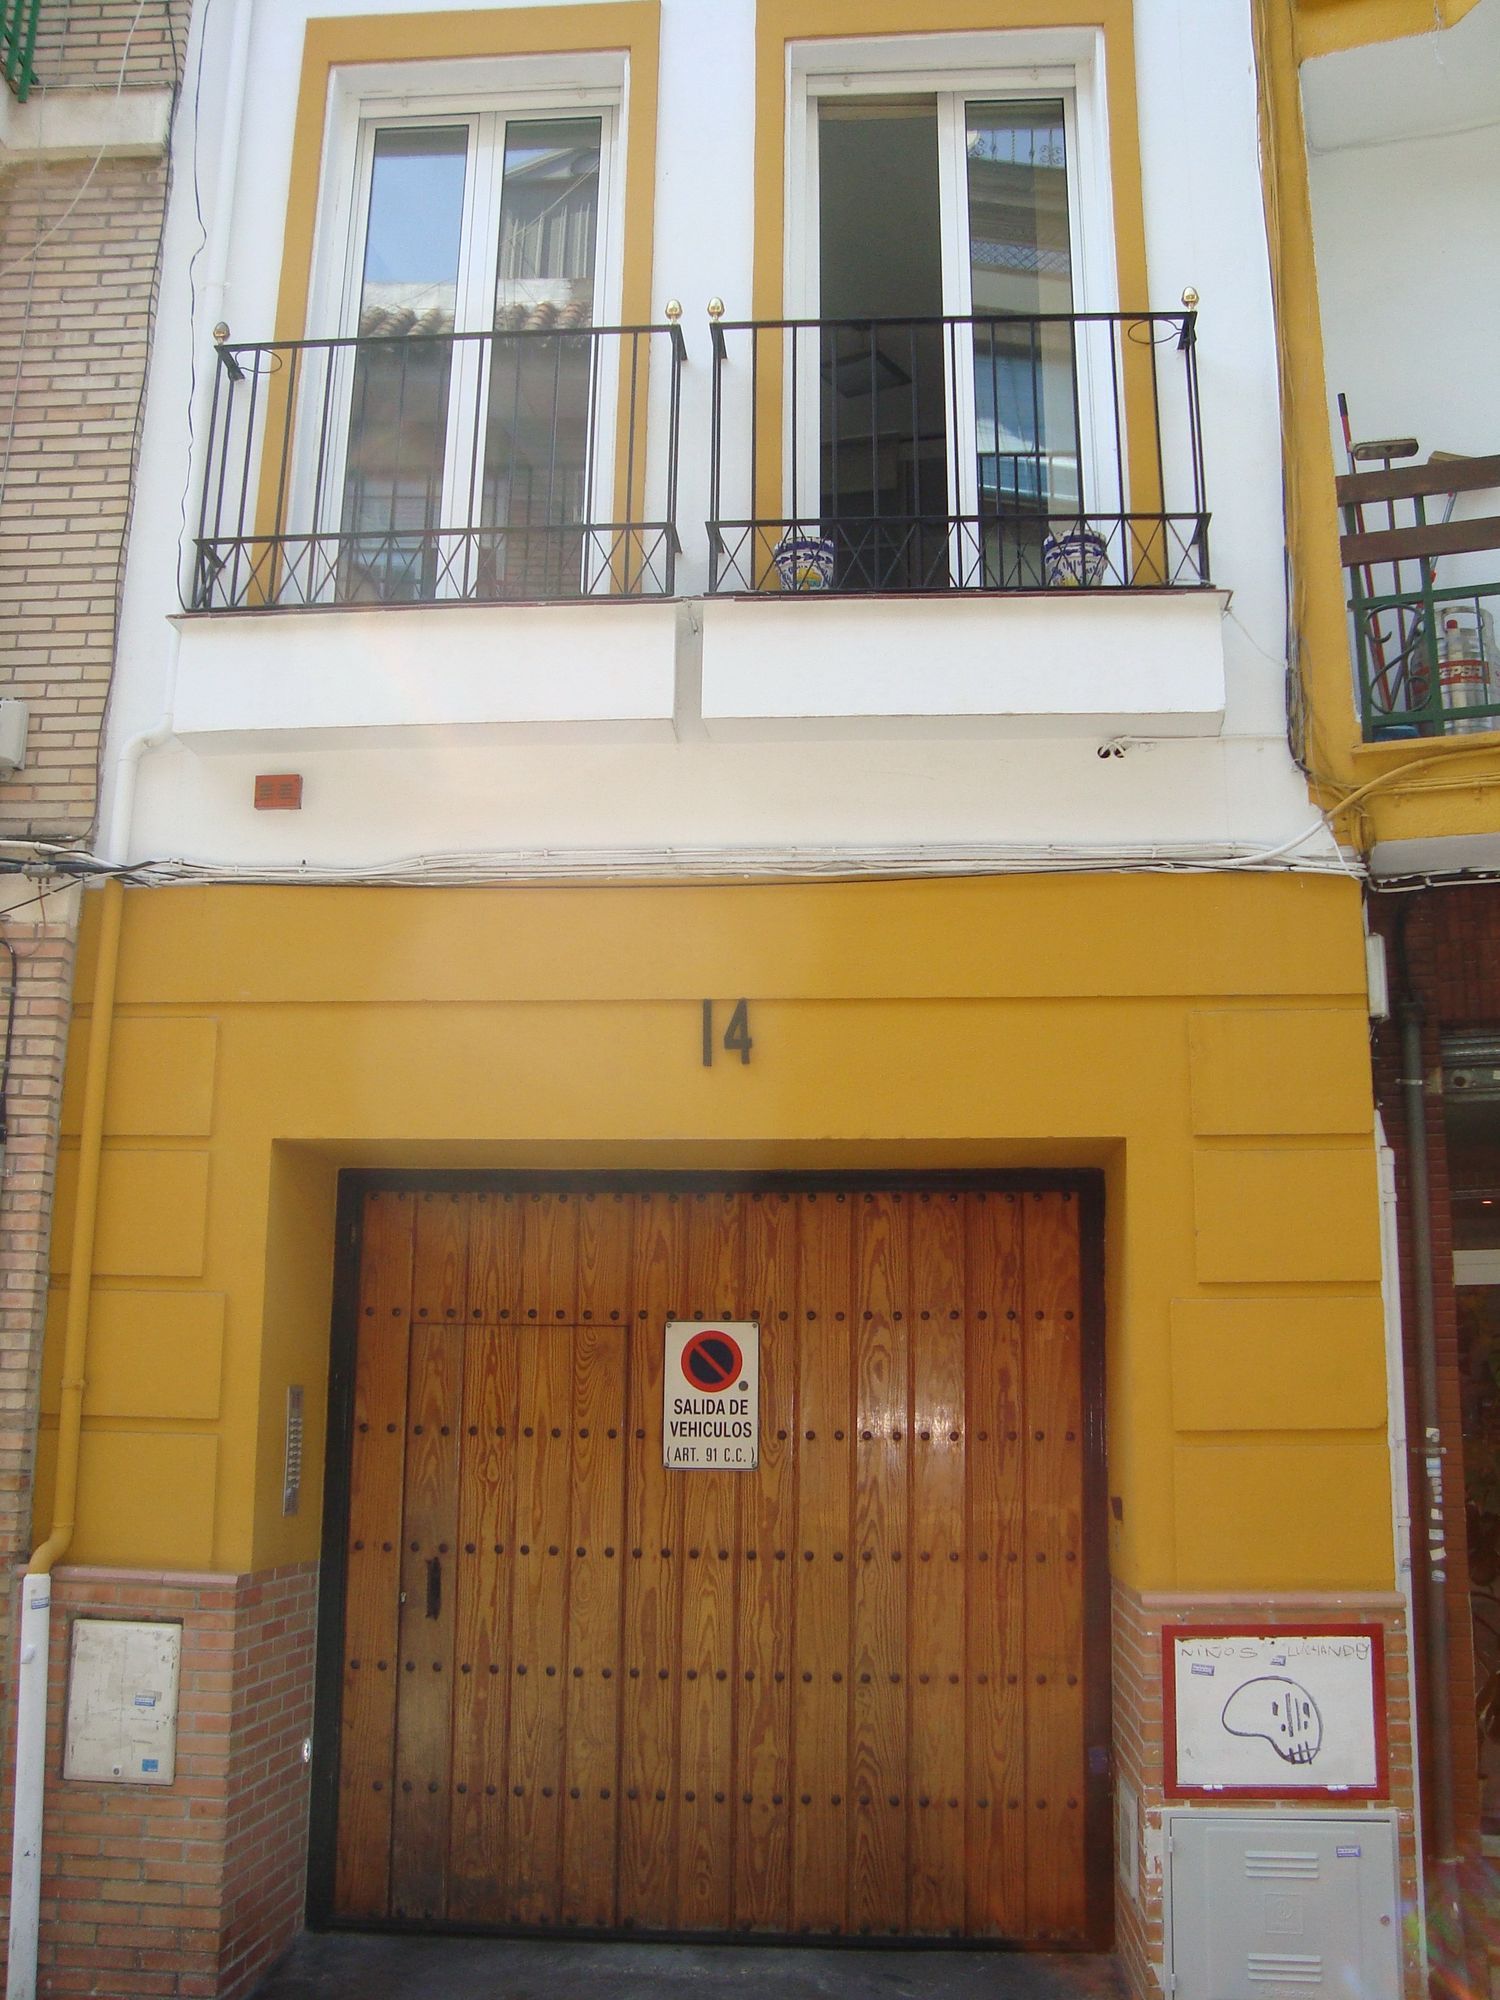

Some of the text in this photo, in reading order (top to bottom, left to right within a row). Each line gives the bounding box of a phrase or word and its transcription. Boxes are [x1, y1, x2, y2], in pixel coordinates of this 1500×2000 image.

[1438, 664, 1484, 679] EPSA
[702, 997, 752, 1067] 14
[673, 1398, 749, 1416] SALIDA DE
[670, 1421, 752, 1438] VEHICULOS
[706, 1447, 718, 1463] 91
